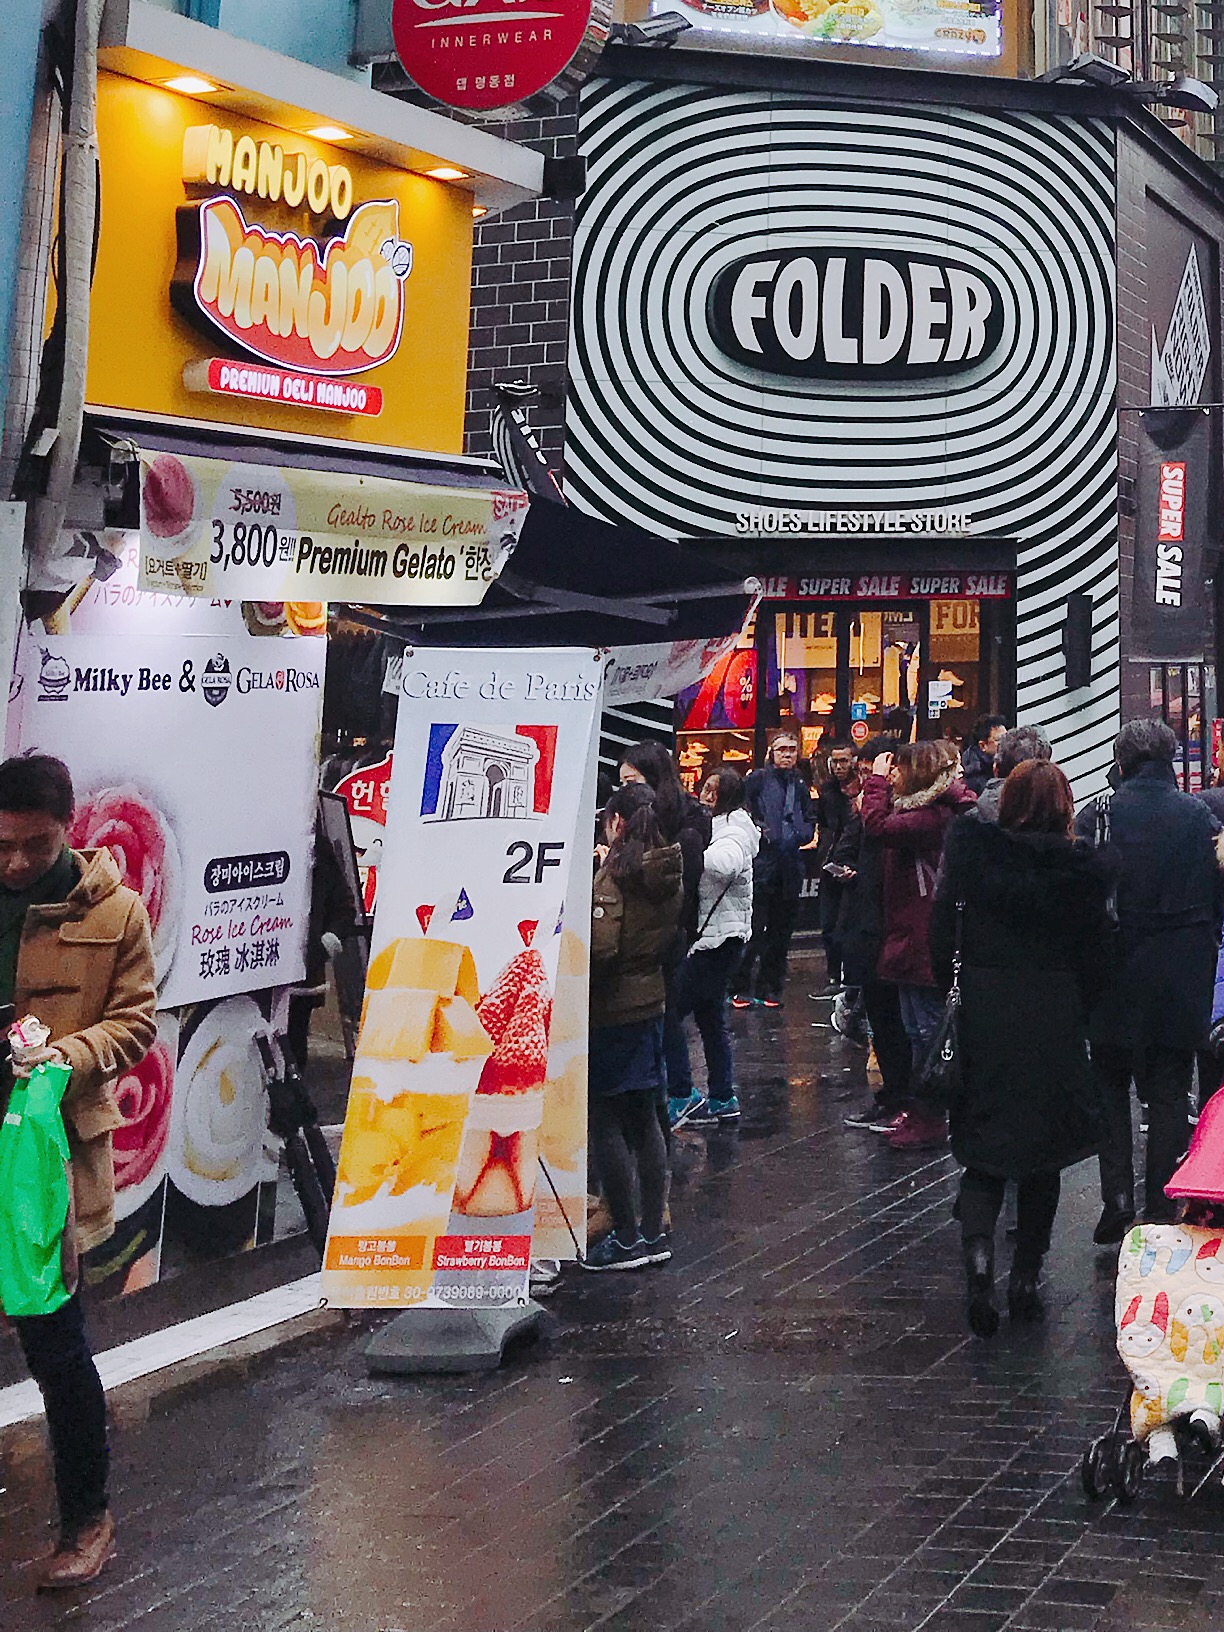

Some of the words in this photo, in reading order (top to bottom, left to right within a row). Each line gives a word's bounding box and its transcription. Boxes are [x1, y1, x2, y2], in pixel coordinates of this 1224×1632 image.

[430, 29, 553, 48] INNERWEAR
[474, 73, 516, 89] 명동점
[206, 126, 352, 220] MANJOO
[202, 236, 403, 359] MANJOO
[731, 257, 992, 365] FOLDER
[220, 364, 280, 400] PREMIUM
[315, 380, 367, 413] MANJOO
[1160, 463, 1185, 540] SUPER
[328, 503, 376, 529] Gealto
[383, 508, 416, 533] Rose
[420, 512, 438, 534] Ice
[442, 514, 487, 536] Cream
[737, 510, 801, 533] SHOES
[807, 510, 907, 532] LIFESTYLE
[911, 509, 972, 533] STORE
[210, 519, 278, 572] 3,800
[296, 536, 387, 578] Premium
[392, 542, 455, 581] Gelato
[799, 578, 851, 595] SUPER
[857, 575, 900, 596] SALE
[910, 576, 960, 594] SUPER
[966, 574, 1007, 595] SALE
[1154, 544, 1182, 607] SALE
[73, 667, 133, 696] Milky
[138, 667, 171, 691] Bee
[179, 659, 196, 693] &
[237, 667, 274, 694] GELA
[285, 667, 320, 693] ROSA
[403, 670, 469, 701] Cafe
[479, 671, 515, 701] de
[525, 672, 597, 702] Paris
[211, 856, 284, 887] 장미아이스크림
[503, 840, 565, 885] 2F
[204, 892, 284, 916] バラのアイスクリーム
[191, 924, 223, 946] Rose
[228, 919, 246, 940] Ice
[250, 914, 294, 937] Cream
[199, 945, 230, 979] 玫瑰
[339, 1255, 371, 1267] Mango
[374, 1254, 411, 1267] BonBon
[436, 1254, 487, 1268] Strawberry
[488, 1255, 526, 1267] BonBon
